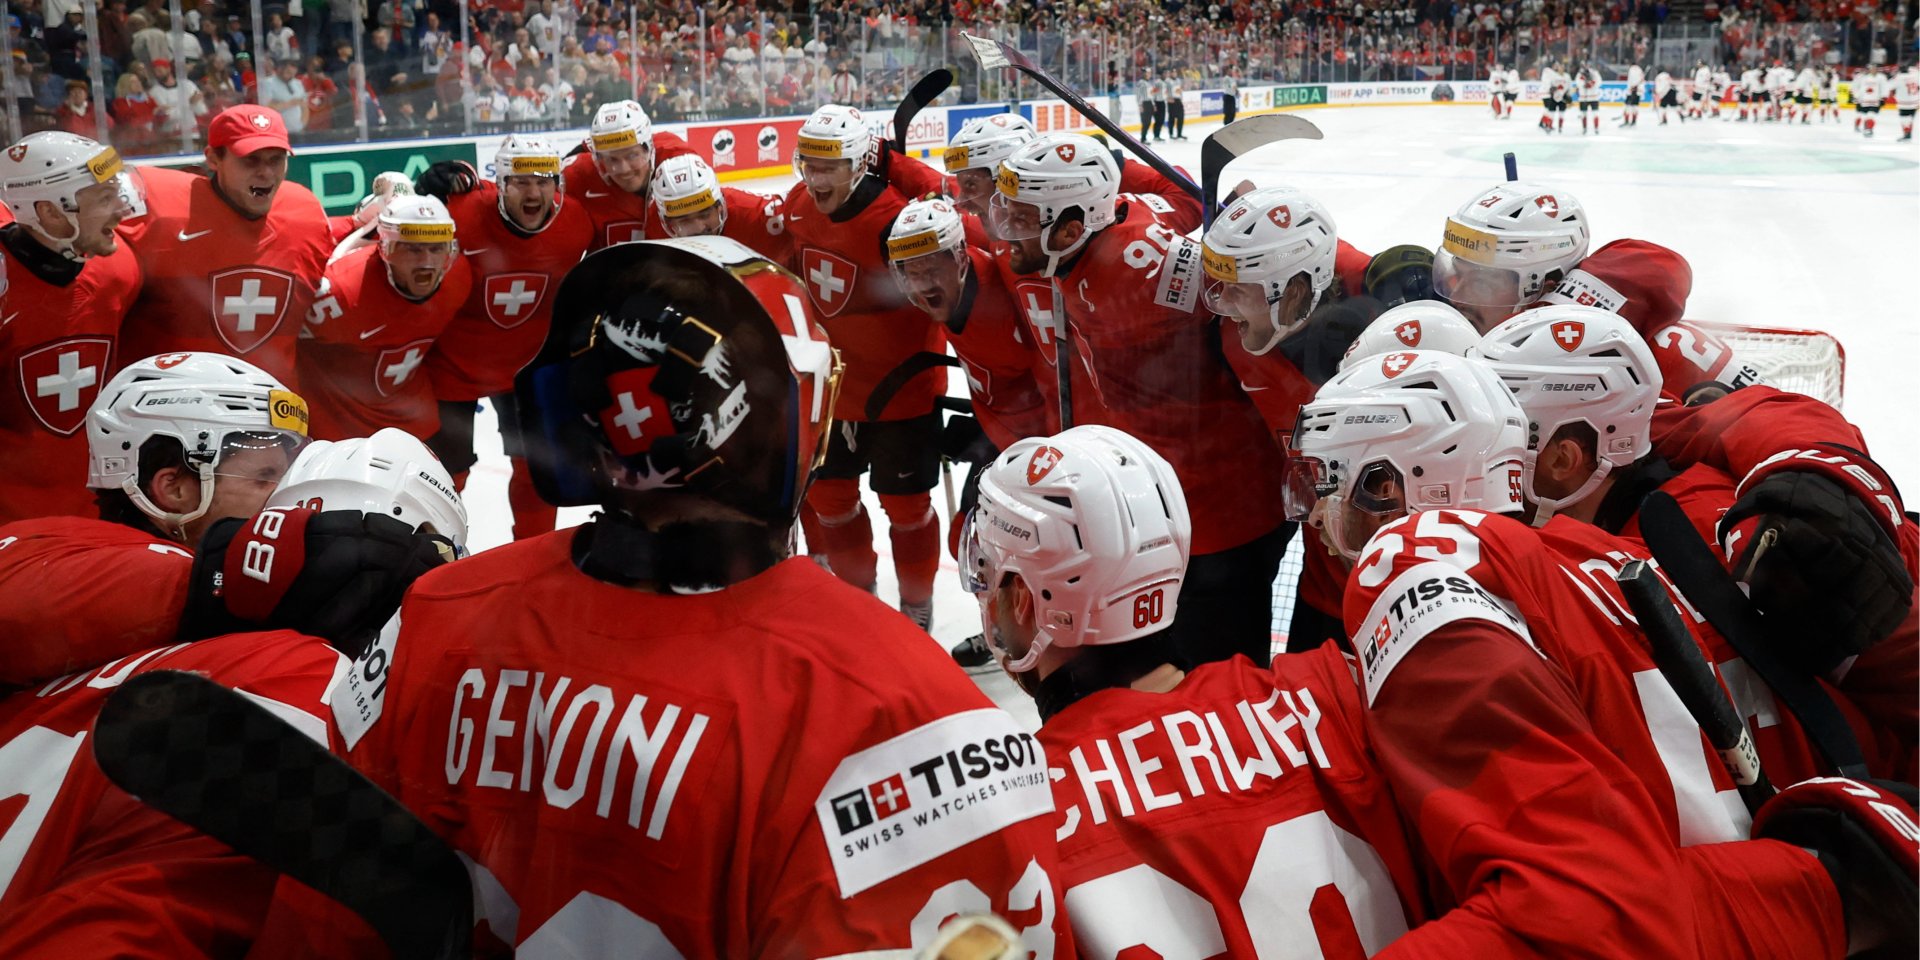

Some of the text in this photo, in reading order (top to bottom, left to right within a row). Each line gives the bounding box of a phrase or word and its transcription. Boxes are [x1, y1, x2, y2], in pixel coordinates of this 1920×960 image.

[1354, 88, 1372, 97] APP
[1391, 86, 1427, 95] TISSOT
[818, 116, 832, 125] 79
[674, 173, 687, 184] 97
[1478, 195, 1502, 208] 21
[902, 215, 917, 225] 92
[1228, 206, 1247, 221] 18
[1078, 277, 1096, 313] C
[1542, 383, 1596, 392] BAUER
[146, 396, 203, 406] BAUER
[1344, 414, 1399, 425] BAUER
[419, 470, 457, 503] BAUER
[1508, 469, 1522, 503] 55
[1132, 588, 1164, 630] 60
[1391, 600, 1443, 646] WATCHES
[354, 691, 372, 722] 1853
[444, 667, 710, 841] GENONI
[910, 732, 1037, 799] TISSOT
[1050, 686, 1331, 842] HERWEY
[843, 822, 905, 858] SWISS
[913, 785, 998, 828] WATCHES
